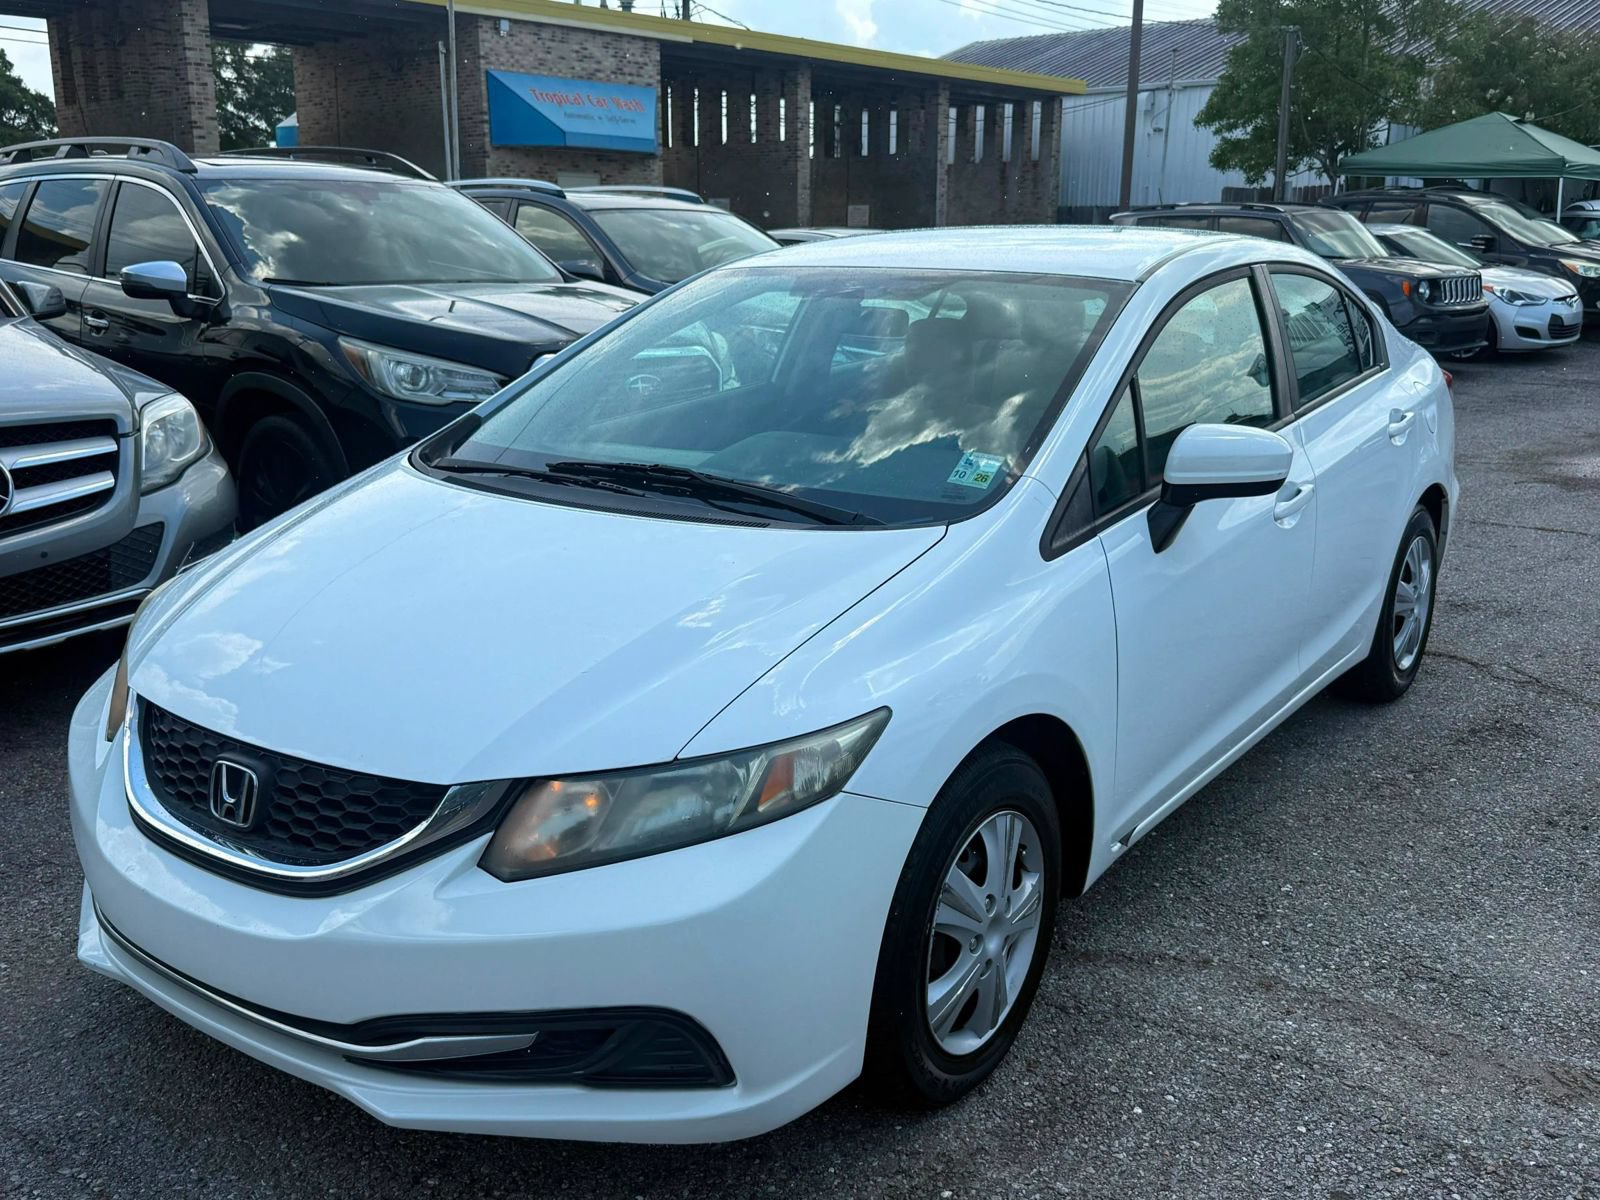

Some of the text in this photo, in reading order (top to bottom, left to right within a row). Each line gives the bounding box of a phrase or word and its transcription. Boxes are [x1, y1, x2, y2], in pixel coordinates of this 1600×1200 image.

[529, 87, 645, 112] Tropical Car Wash
[953, 469, 967, 479] 10
[974, 473, 990, 483] 26
